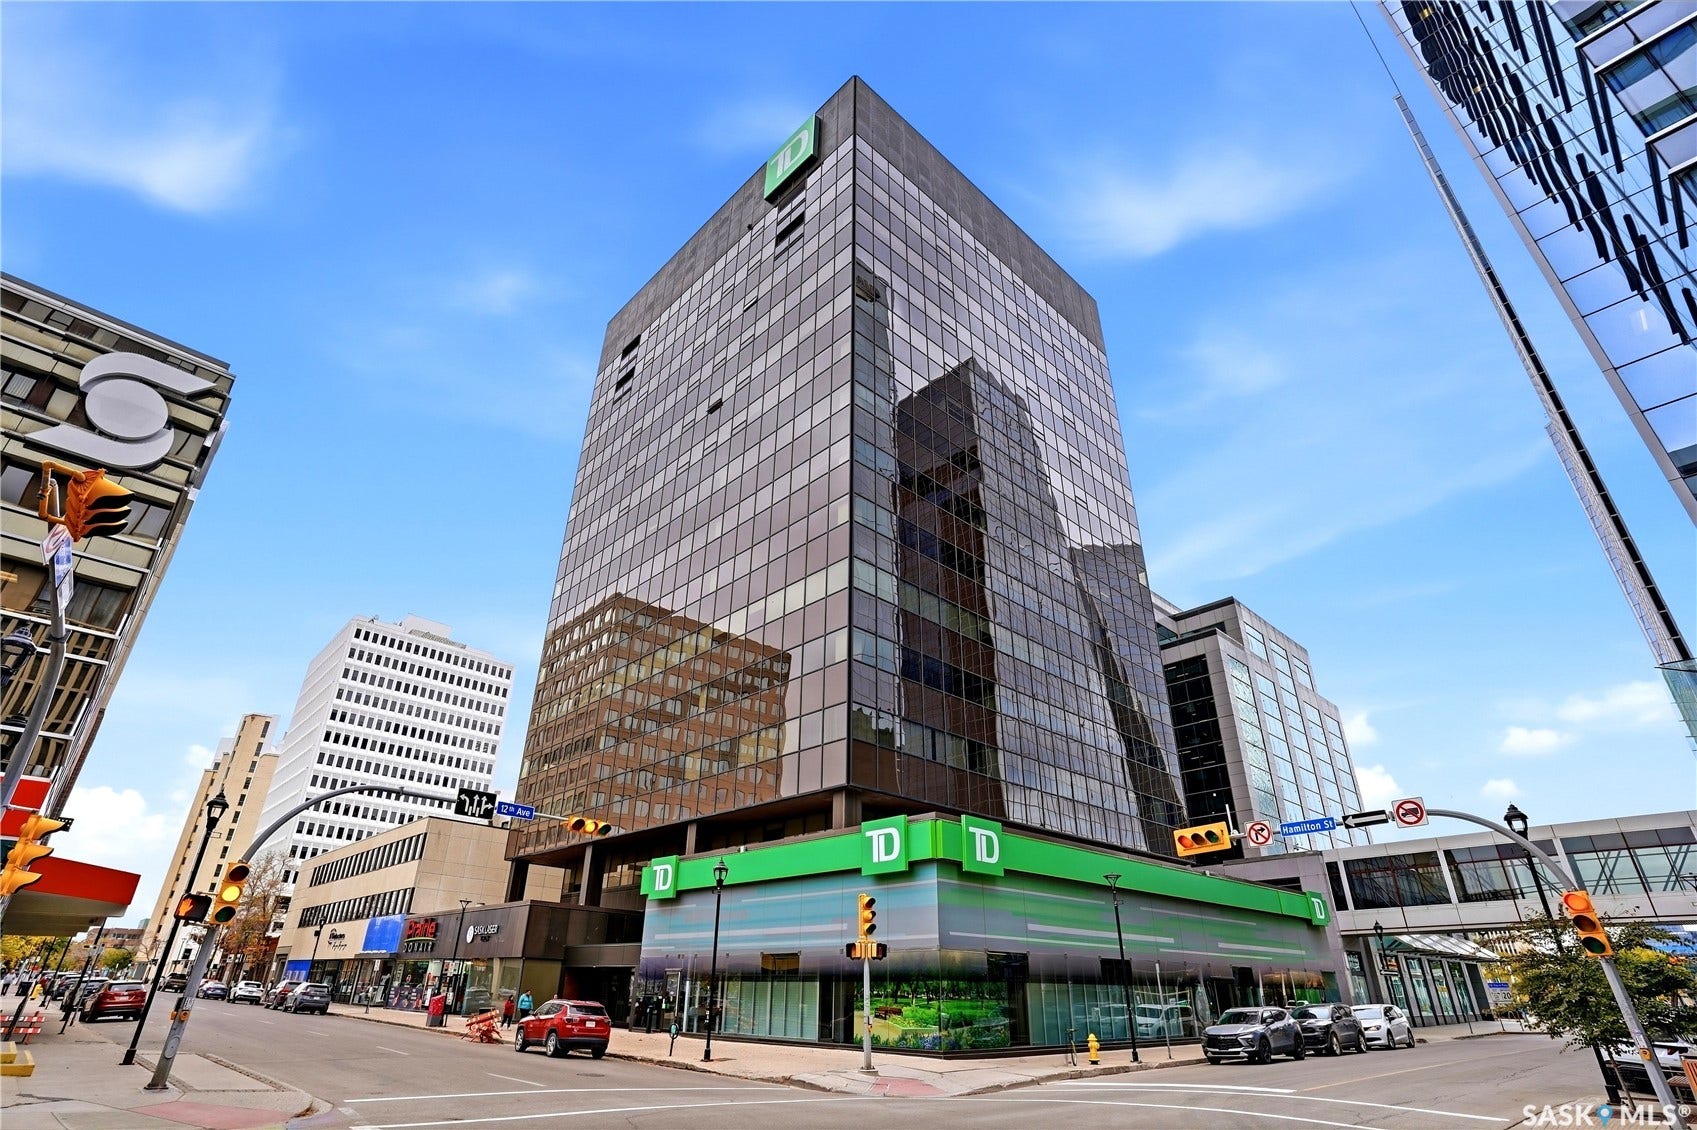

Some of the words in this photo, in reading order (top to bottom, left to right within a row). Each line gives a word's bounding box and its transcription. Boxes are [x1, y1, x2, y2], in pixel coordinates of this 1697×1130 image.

[770, 129, 809, 178] TD
[500, 804, 515, 814] 12th
[516, 807, 531, 817] Ave
[1282, 821, 1321, 836] Hamilton
[1323, 819, 1334, 829] St
[865, 827, 901, 864] TD
[968, 826, 1000, 864] TD
[652, 863, 673, 891] TD
[1310, 897, 1325, 919] TD
[406, 918, 436, 939] Prairie
[402, 941, 433, 953] DONAIR
